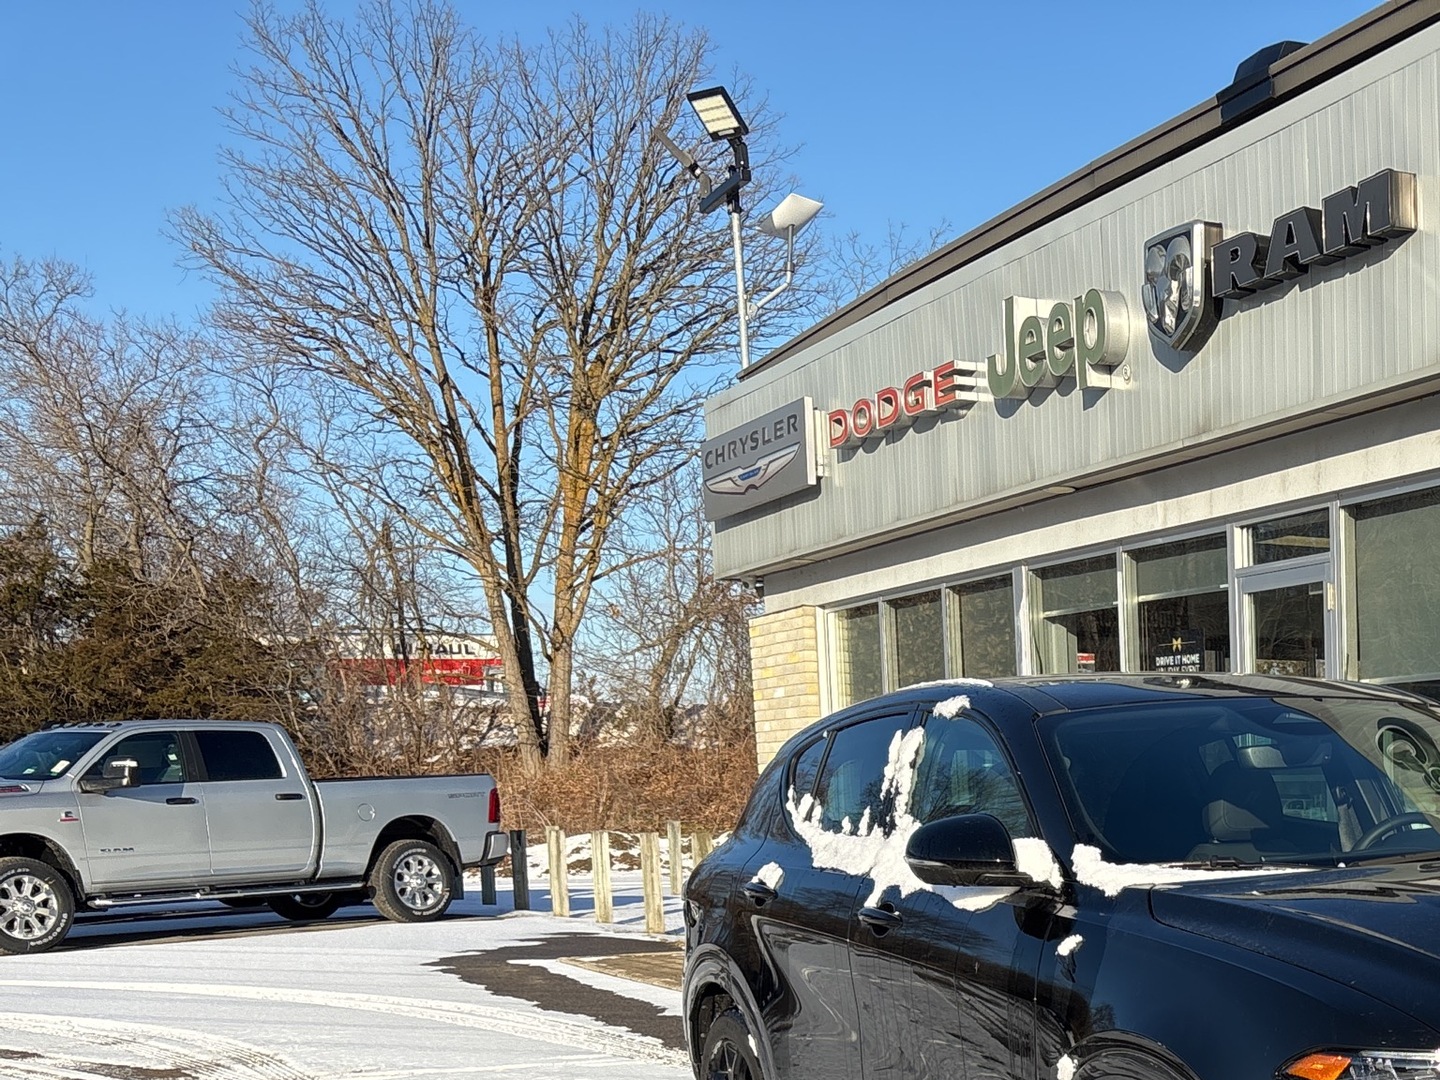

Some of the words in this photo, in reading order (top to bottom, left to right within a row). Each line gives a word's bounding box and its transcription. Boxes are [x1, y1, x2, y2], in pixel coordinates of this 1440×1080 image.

[1210, 168, 1398, 299] RAM
[986, 288, 1112, 400] Jeep
[704, 414, 799, 469] CHRYSLER
[827, 359, 957, 448] DODGE
[1155, 655, 1174, 666] DRIVE
[1174, 654, 1181, 665] IT
[1182, 653, 1200, 664] HOME
